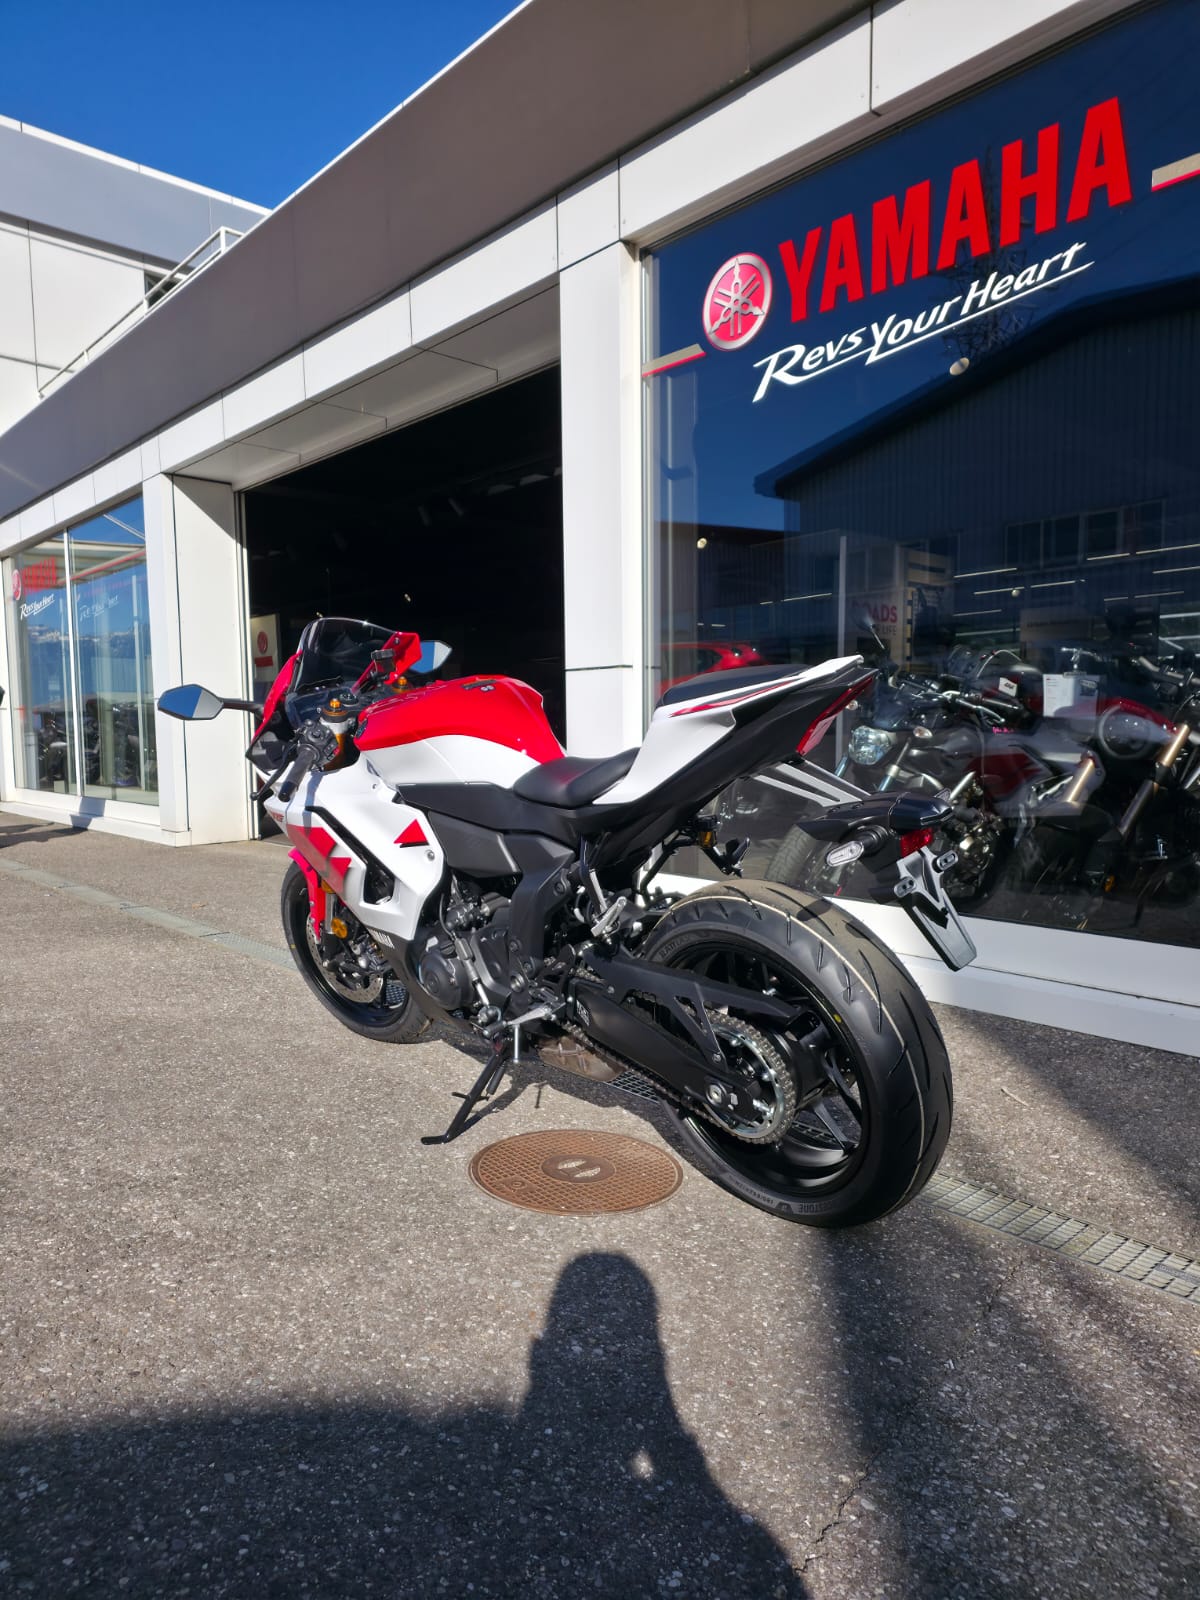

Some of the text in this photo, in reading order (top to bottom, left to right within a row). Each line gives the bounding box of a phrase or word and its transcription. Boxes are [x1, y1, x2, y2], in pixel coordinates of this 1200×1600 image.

[778, 96, 1133, 322] YAMAHA
[752, 241, 1094, 403] Revs Your Heart
